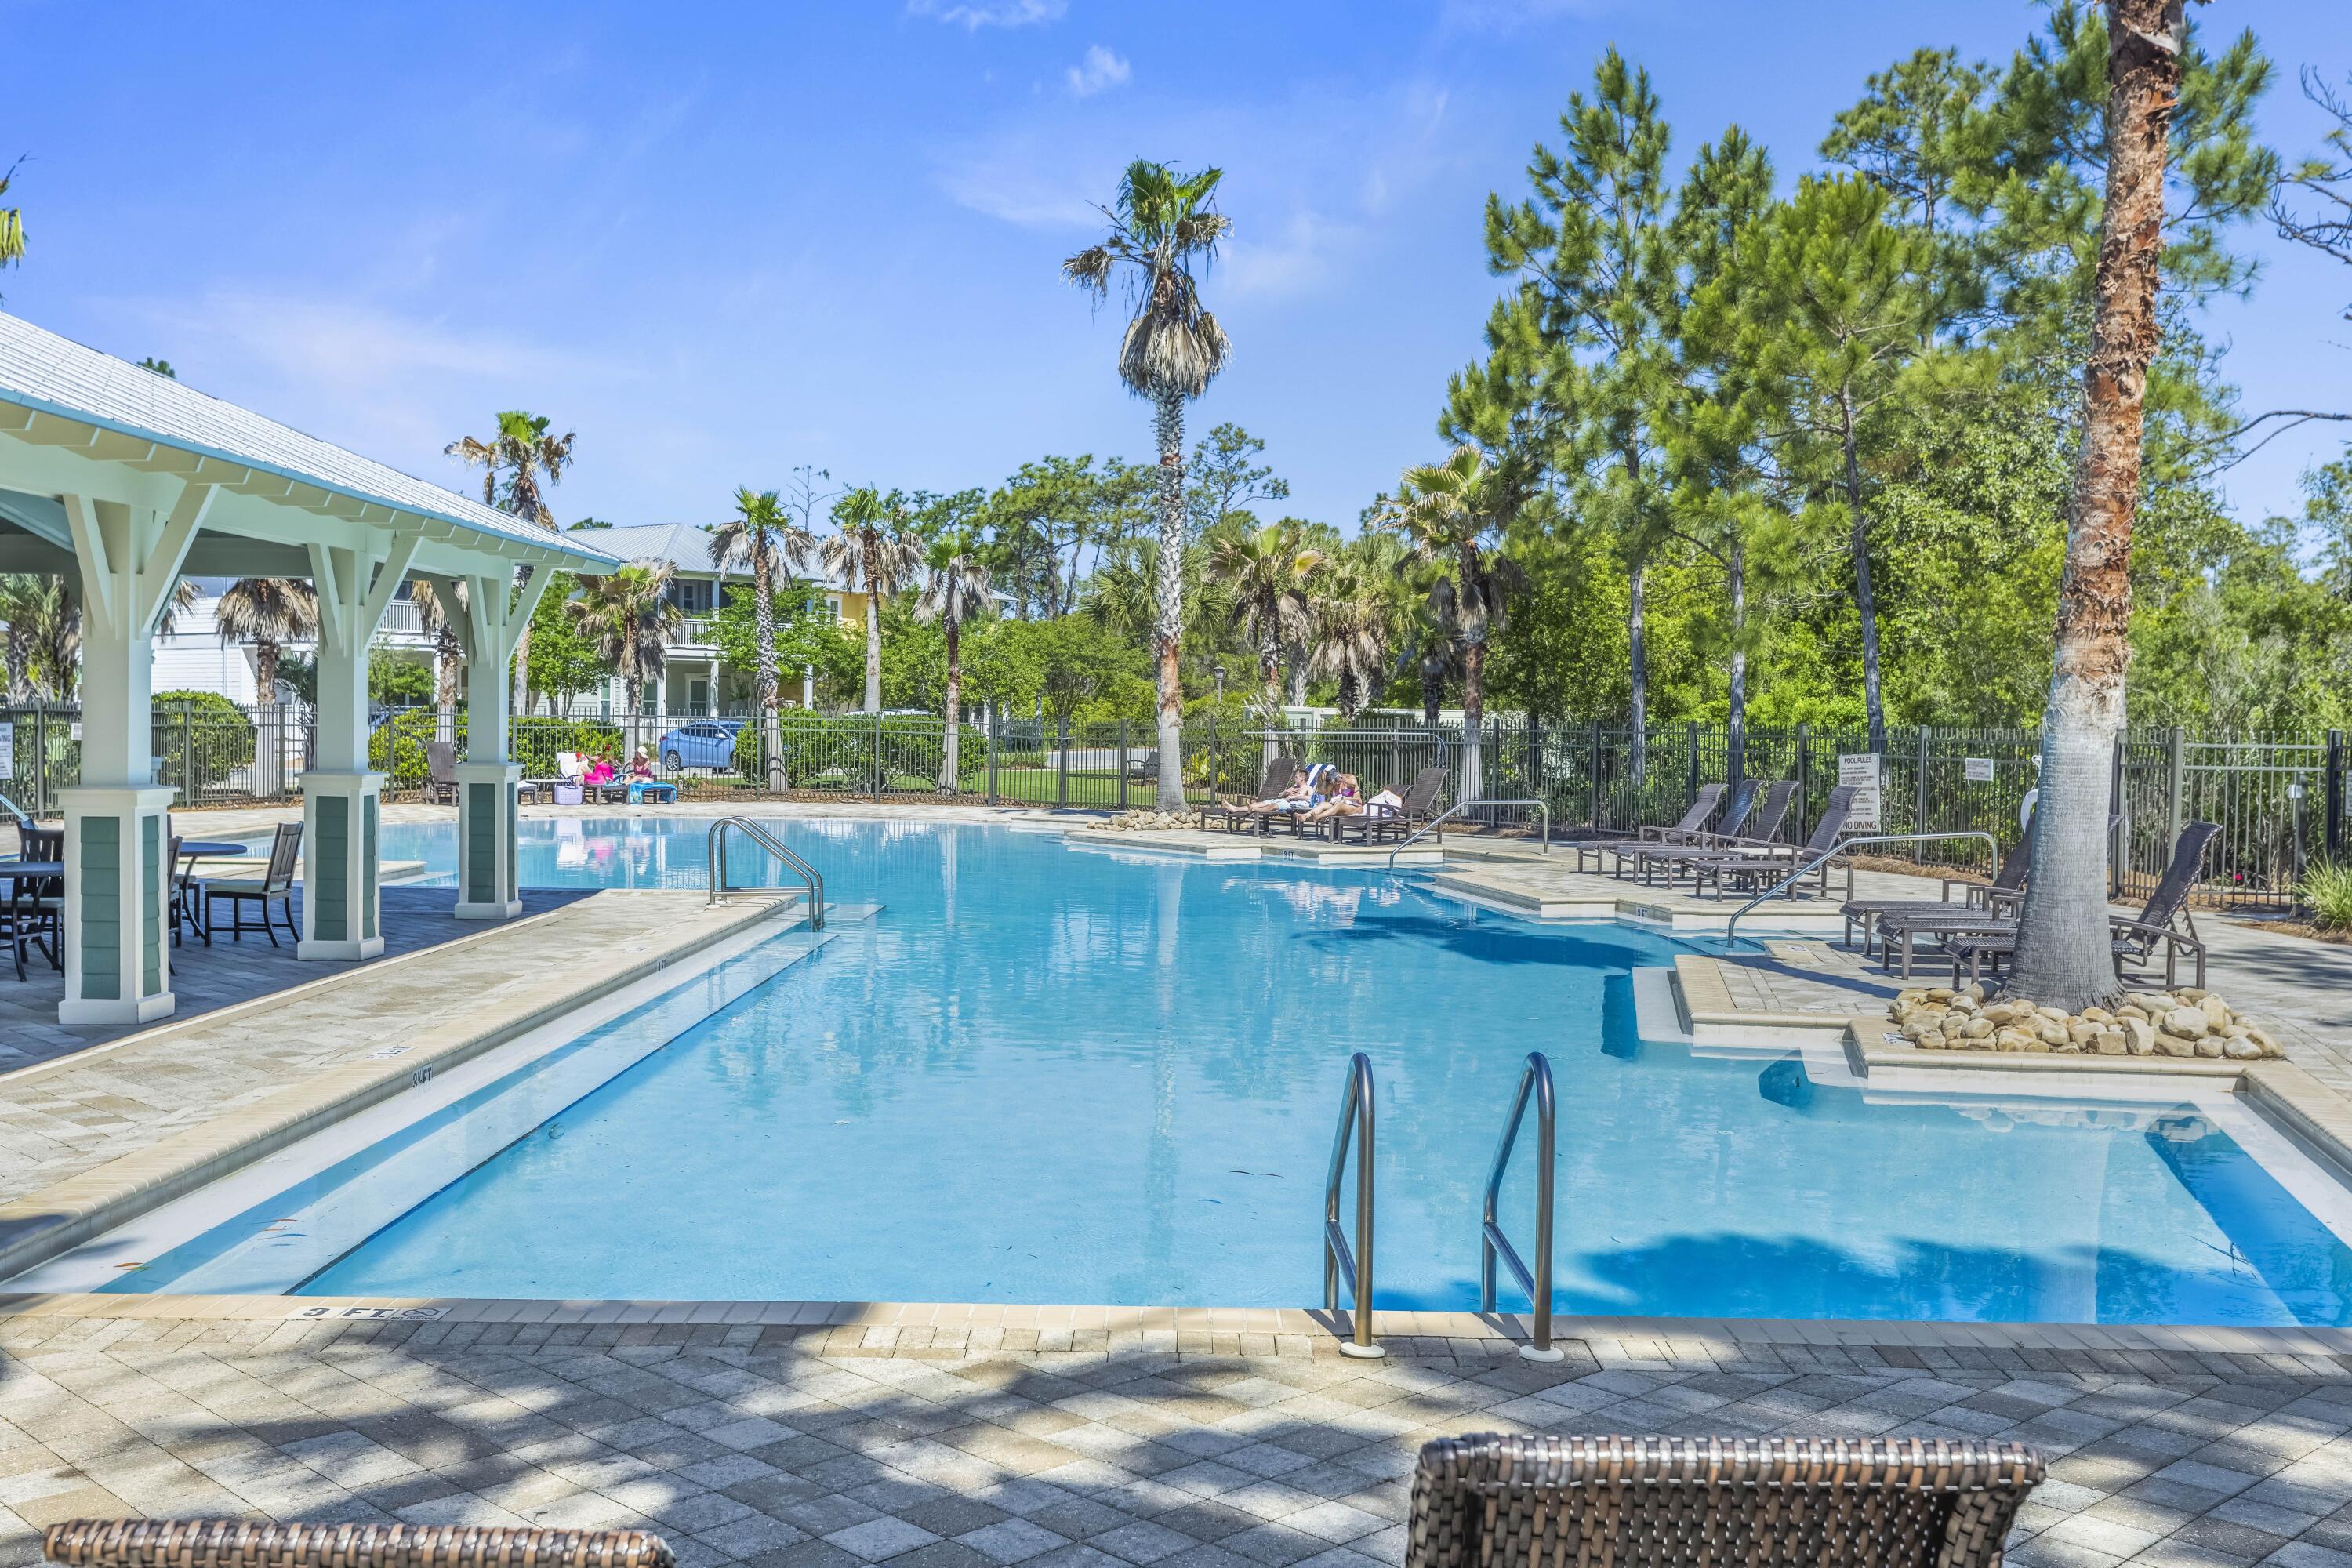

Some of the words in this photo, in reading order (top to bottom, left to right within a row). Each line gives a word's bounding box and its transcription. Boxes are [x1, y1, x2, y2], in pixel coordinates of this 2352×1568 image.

[1843, 821, 1853, 829] NO
[1853, 820, 1877, 829] DIVING
[423, 1066, 432, 1083] FT
[303, 1308, 331, 1316] 3
